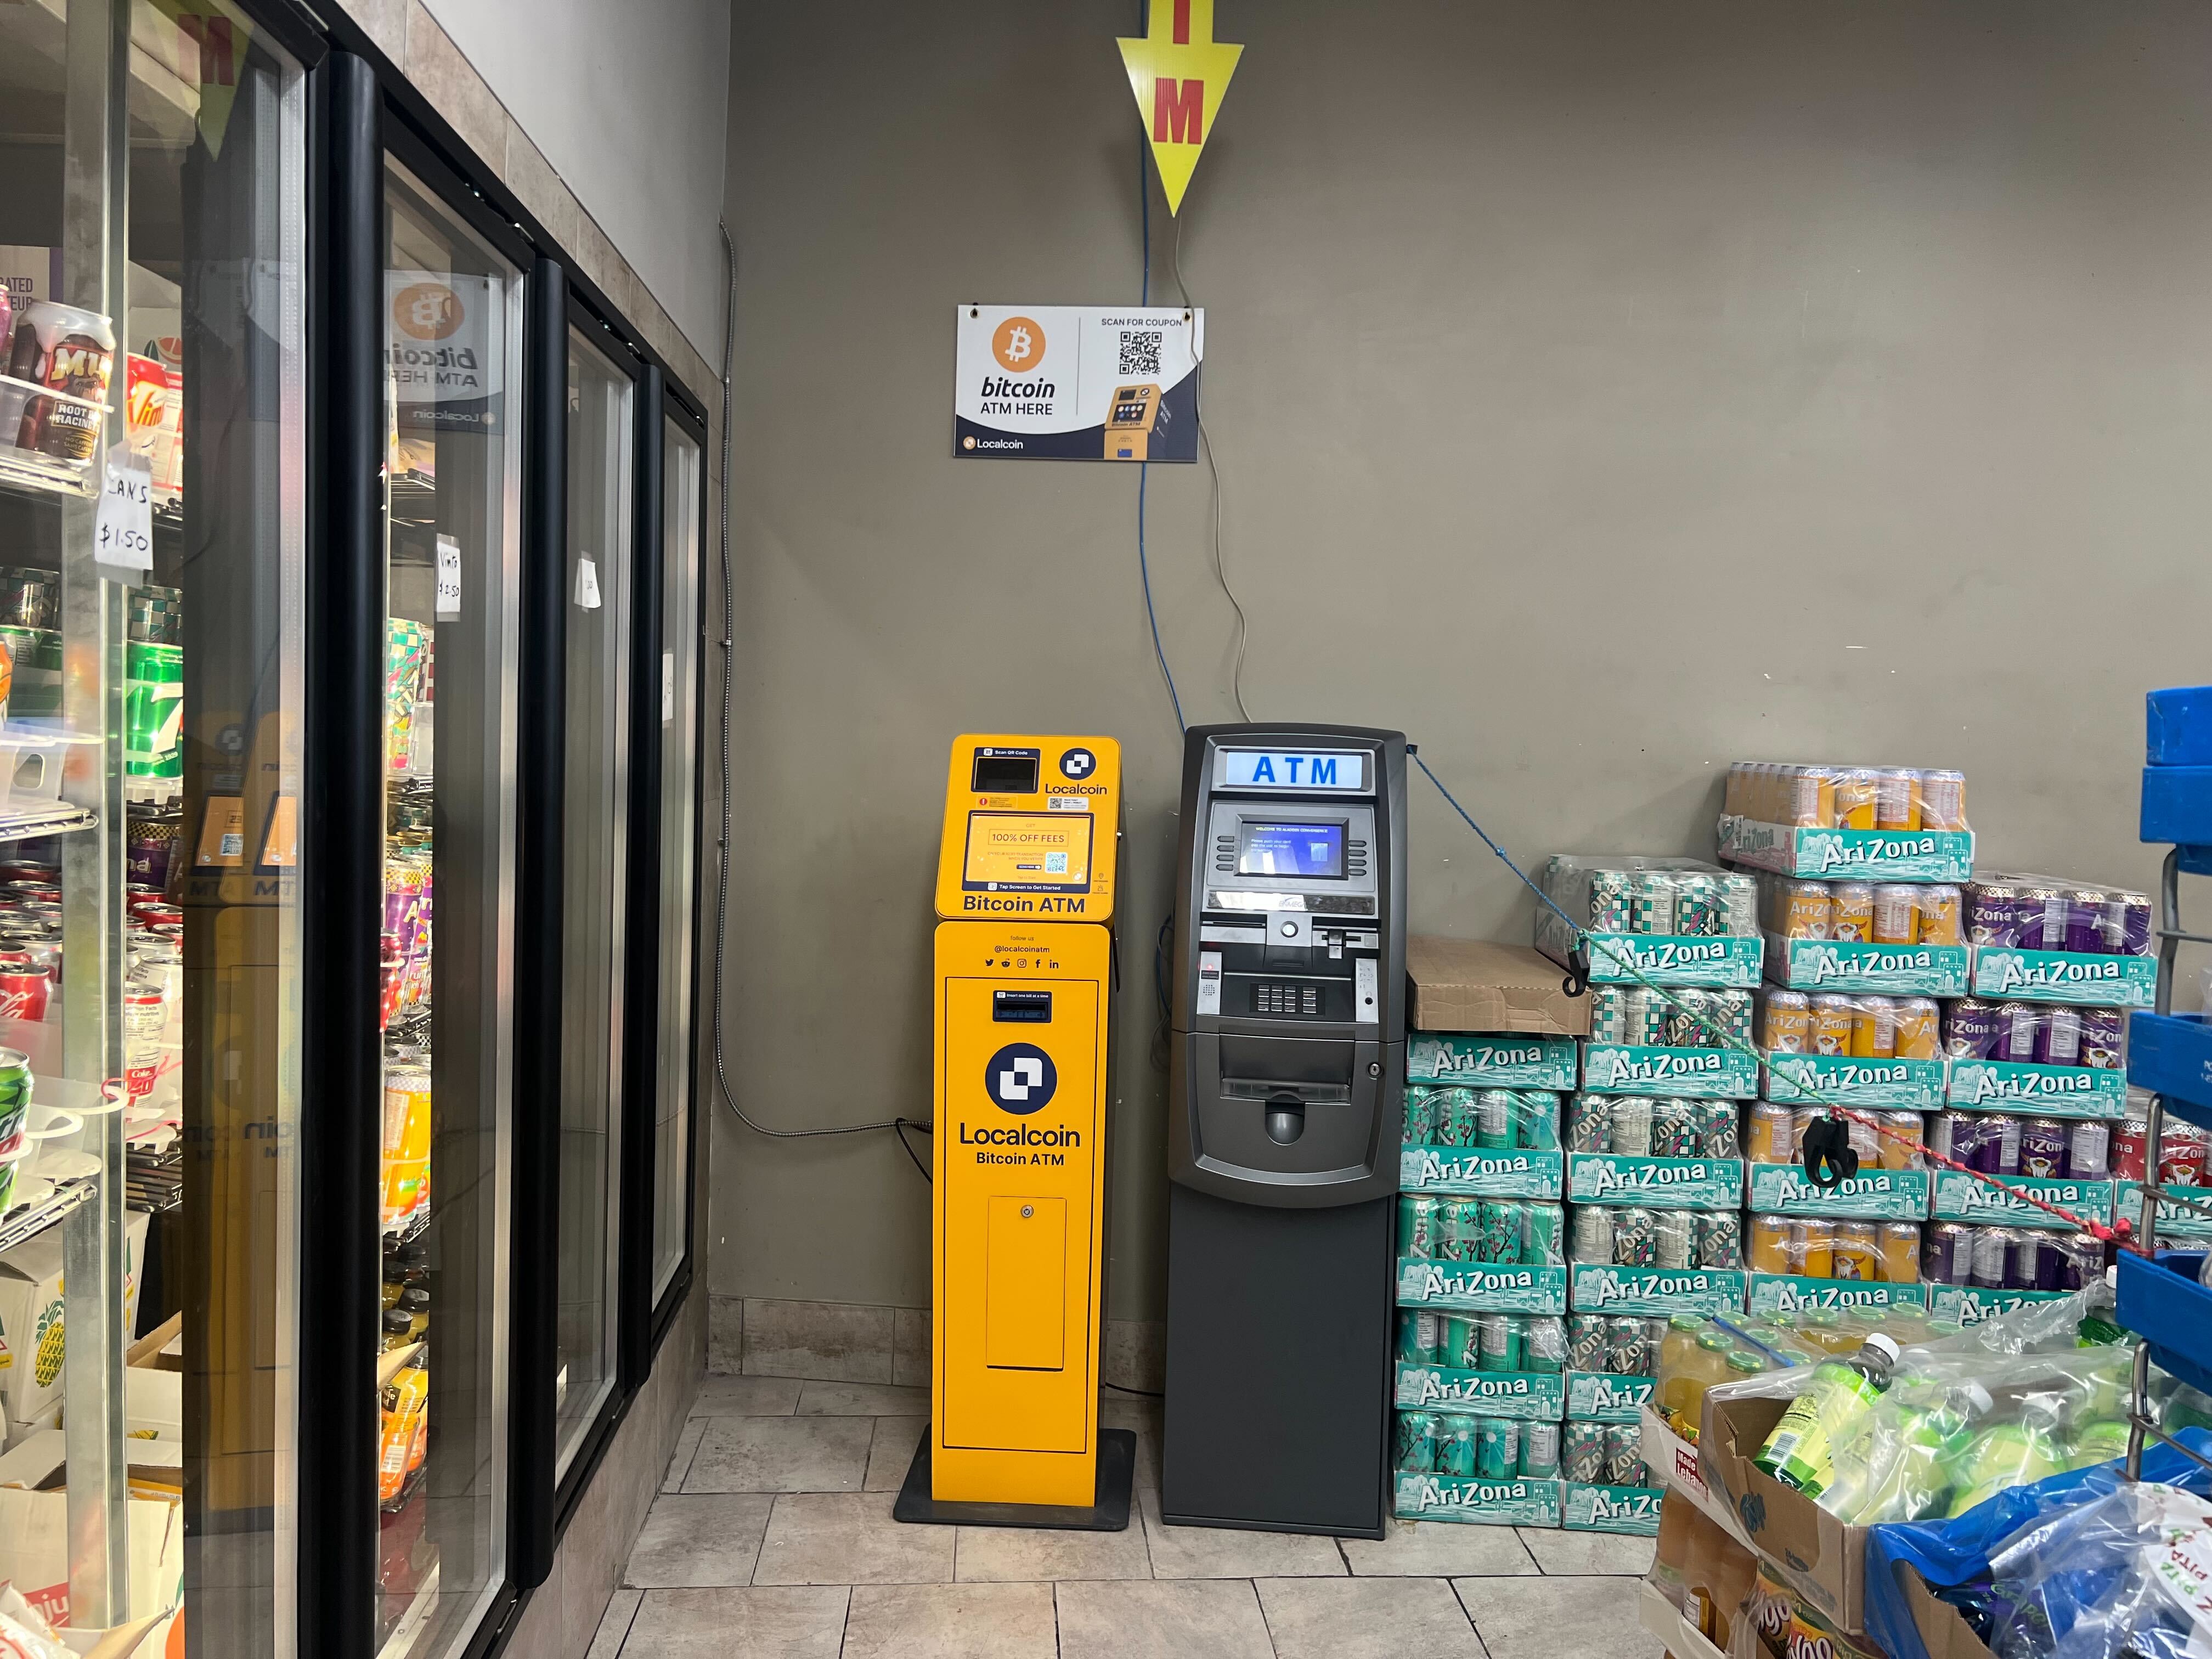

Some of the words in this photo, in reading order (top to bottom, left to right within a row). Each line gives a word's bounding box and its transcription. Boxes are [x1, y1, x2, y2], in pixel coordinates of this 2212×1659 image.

[1101, 318, 1126, 326] SCAN
[1127, 318, 1144, 327] FOR
[1146, 319, 1183, 328] COUPON
[981, 376, 1055, 399] bitcoin
[980, 402, 1011, 415] ATM
[1016, 402, 1053, 415] HERE
[977, 438, 1024, 450] Localcoin
[1252, 756, 1337, 785] ATM
[1045, 783, 1108, 795] Localcoin
[992, 833, 1018, 842] 100%
[1019, 834, 1040, 842] OFF
[1041, 834, 1065, 843] FEES
[1819, 838, 1937, 873] AriZona
[963, 895, 1034, 912] Bitcoin
[1039, 898, 1085, 913] ATM
[994, 945, 1050, 954] @localcoinatm
[1813, 951, 1932, 985] AriZona
[1999, 960, 2121, 994] AriZona
[1431, 1046, 1543, 1078] AriZona
[1607, 1053, 1722, 1087] AriZona
[1792, 1064, 1908, 1098] AriZona
[1972, 1073, 2095, 1105] AriZona
[960, 1122, 1081, 1147] Localcoin
[976, 1152, 1026, 1165] Bitcoin
[1030, 1154, 1064, 1166] ATM
[1417, 1155, 1529, 1187] AriZona
[1593, 1164, 1708, 1198] AriZona
[1421, 1269, 1534, 1301] AriZona
[1595, 1274, 1710, 1307] AriZona
[1419, 1376, 1529, 1406] AriZona
[1590, 1383, 1654, 1415] AriZ
[1677, 1451, 1696, 1471] Made
[1418, 1482, 1528, 1513] AriZona
